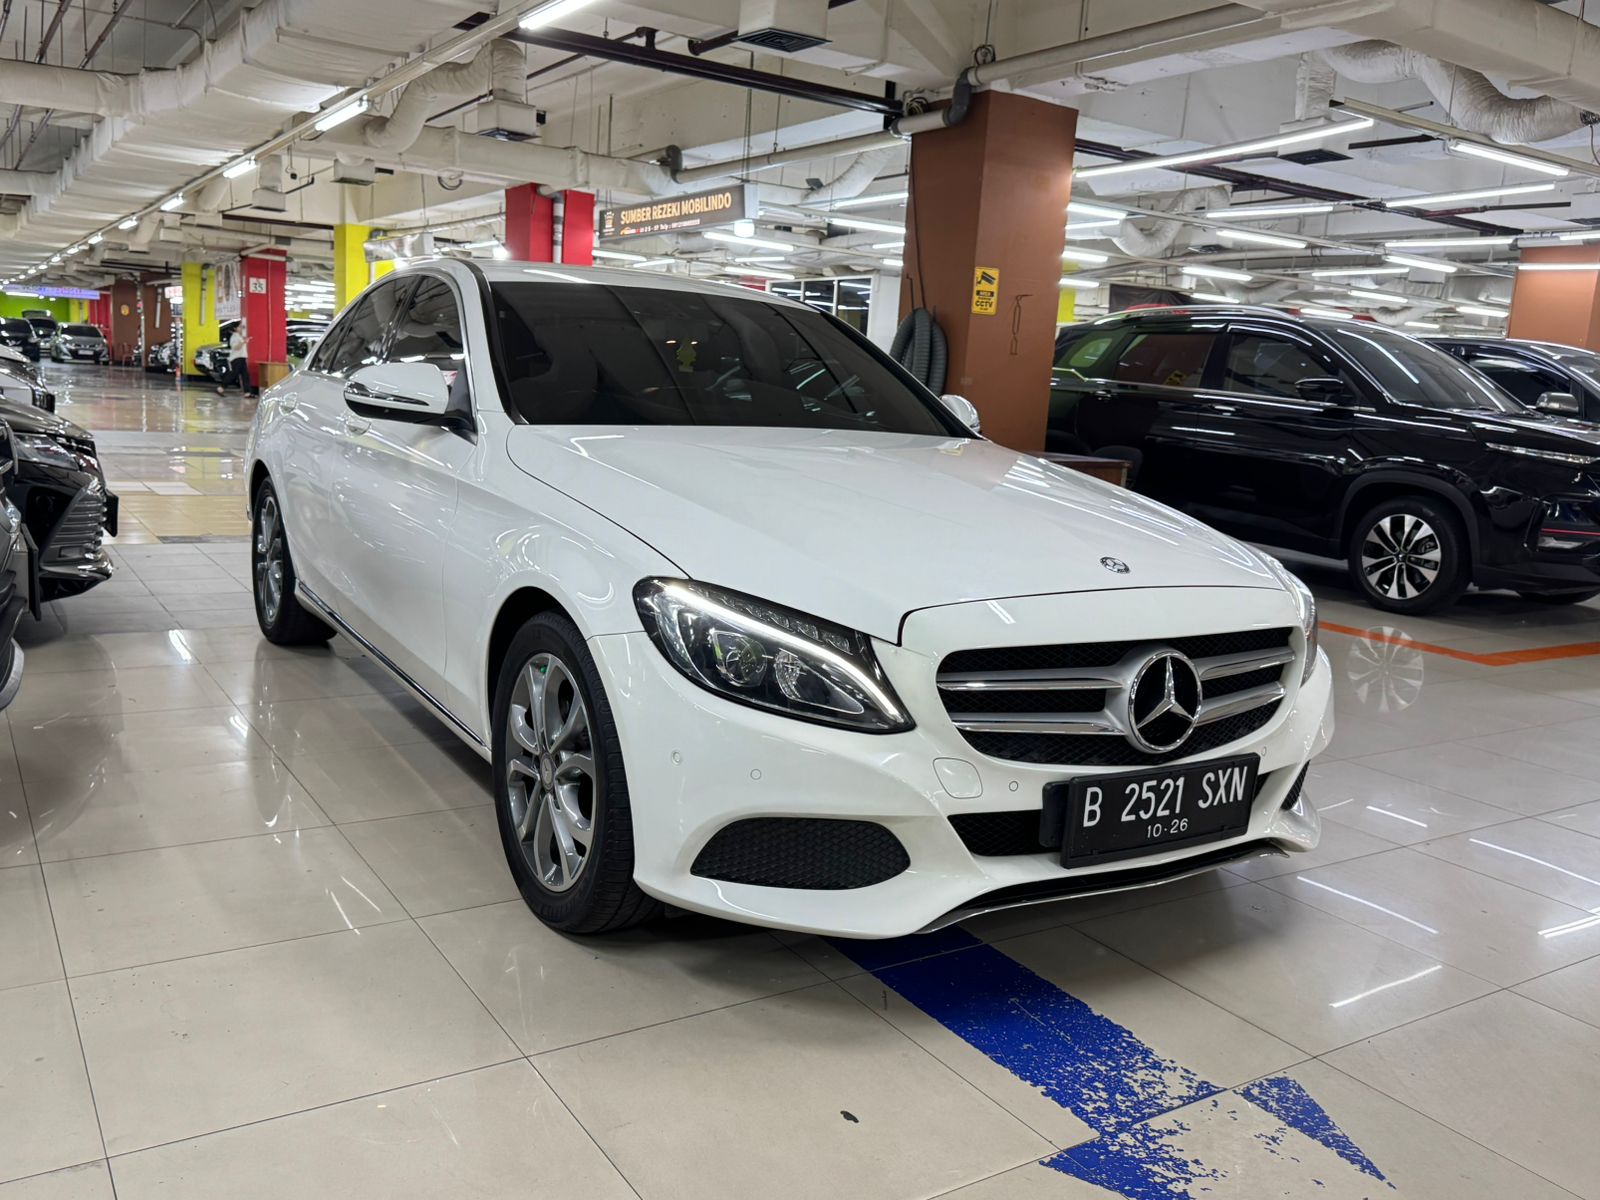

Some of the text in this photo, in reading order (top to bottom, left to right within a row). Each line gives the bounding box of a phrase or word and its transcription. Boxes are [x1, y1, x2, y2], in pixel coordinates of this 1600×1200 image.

[620, 192, 732, 225] SUMBER REZEKI MOBILINDO
[975, 300, 994, 308] CCTV
[1083, 766, 1248, 828] B 2521 SXN
